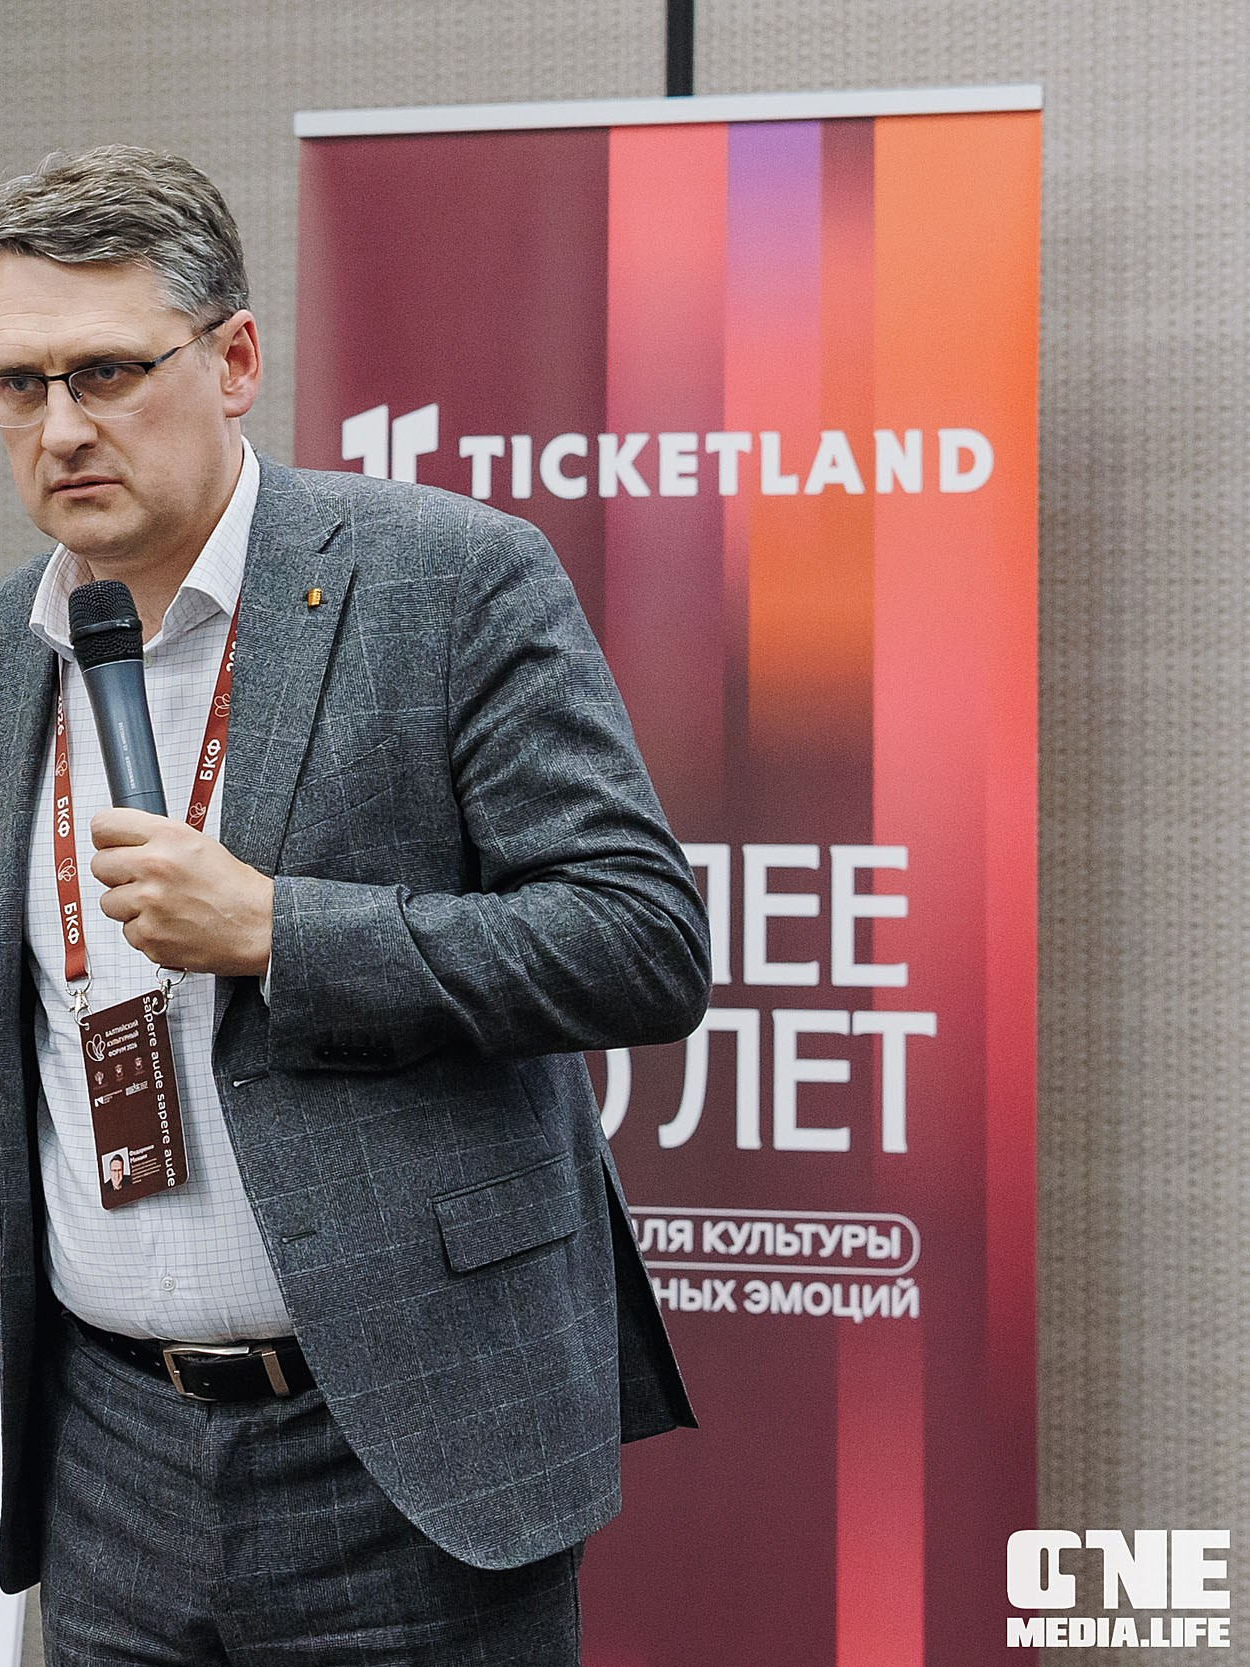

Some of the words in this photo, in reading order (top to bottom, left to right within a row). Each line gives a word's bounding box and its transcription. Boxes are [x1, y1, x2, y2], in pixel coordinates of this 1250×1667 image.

[458, 427, 996, 500] TICKETLAND
[199, 738, 222, 782] БКФ
[56, 795, 70, 838] БКФ
[64, 901, 80, 946] БКФ
[680, 842, 909, 988] ЛЕЕ
[142, 996, 159, 1047] sapere
[151, 1051, 165, 1090] aude
[657, 1007, 938, 1154] ЛЕТ
[156, 1093, 171, 1144] sapere
[165, 1148, 176, 1188] aude
[631, 1218, 695, 1253] ЛЯ
[702, 1220, 902, 1260] КУЛЬТУРЫ
[650, 1276, 738, 1313] НЫХ
[743, 1279, 920, 1323] ЭМОЦИЙ
